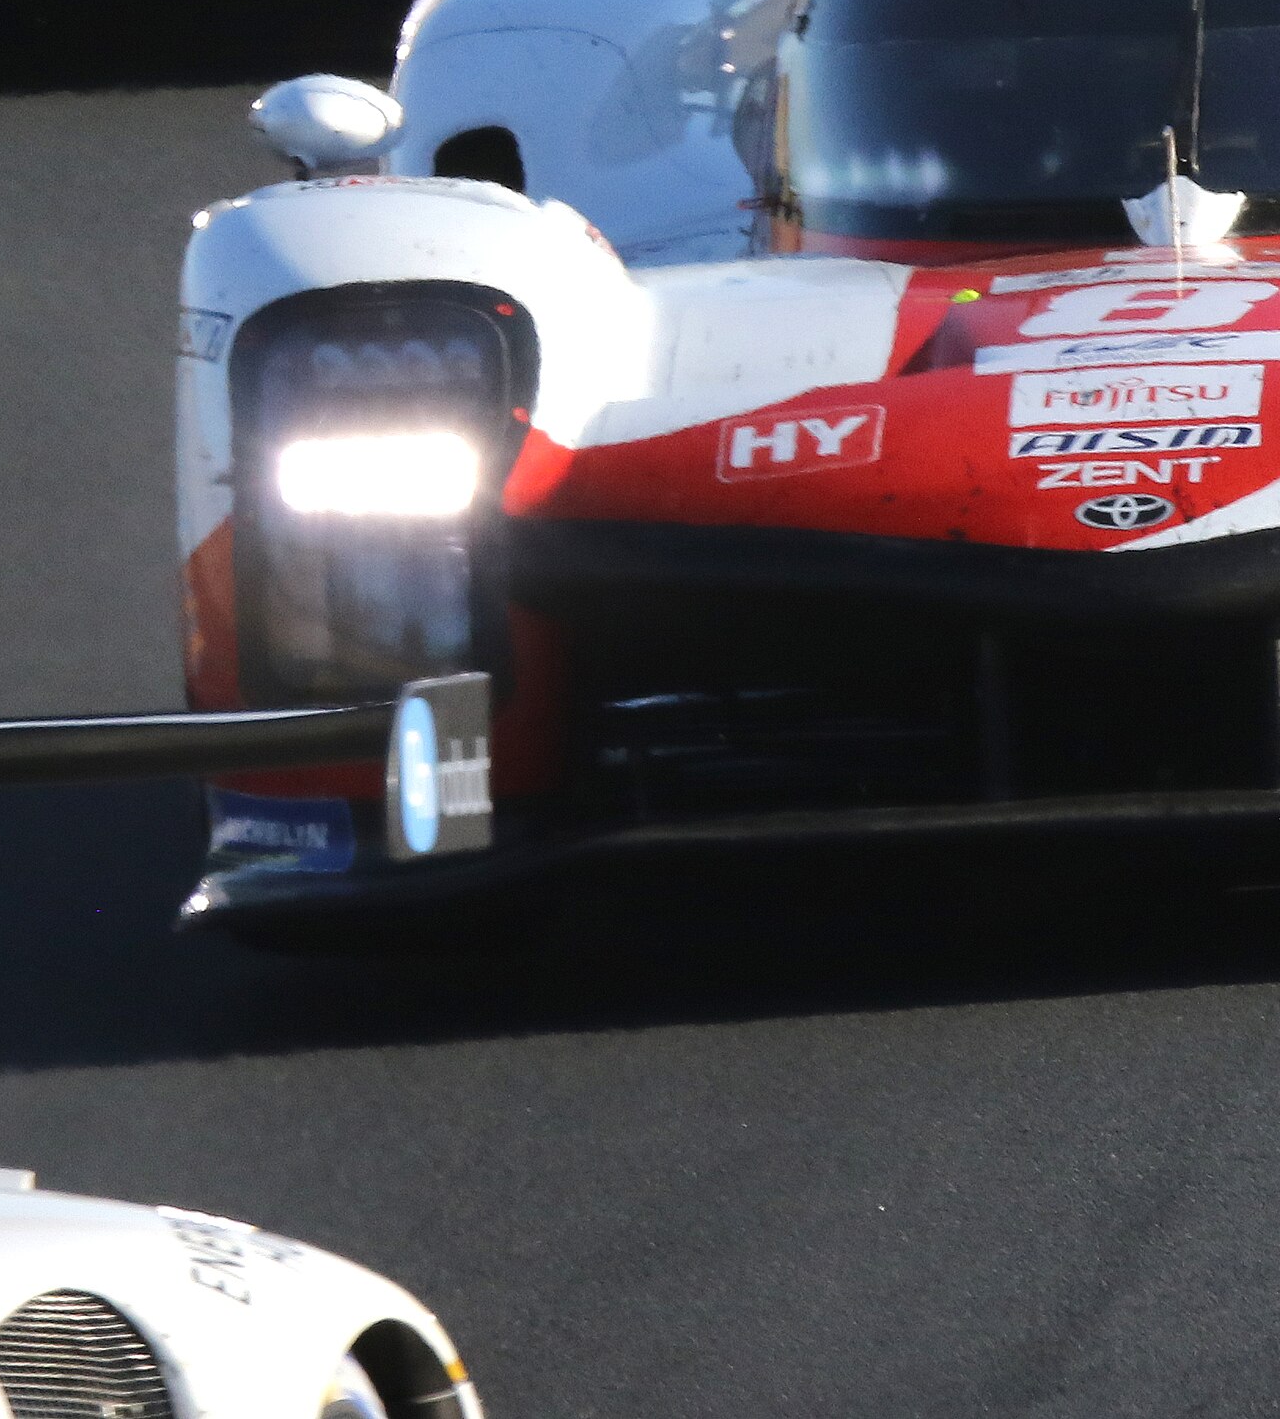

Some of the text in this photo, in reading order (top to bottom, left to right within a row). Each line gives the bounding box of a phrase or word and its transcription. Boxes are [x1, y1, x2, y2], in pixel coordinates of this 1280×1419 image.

[1020, 280, 1280, 337] 8
[1042, 377, 1230, 412] FUJITSU
[729, 414, 870, 469] HY
[1036, 456, 1222, 491] ZENT
